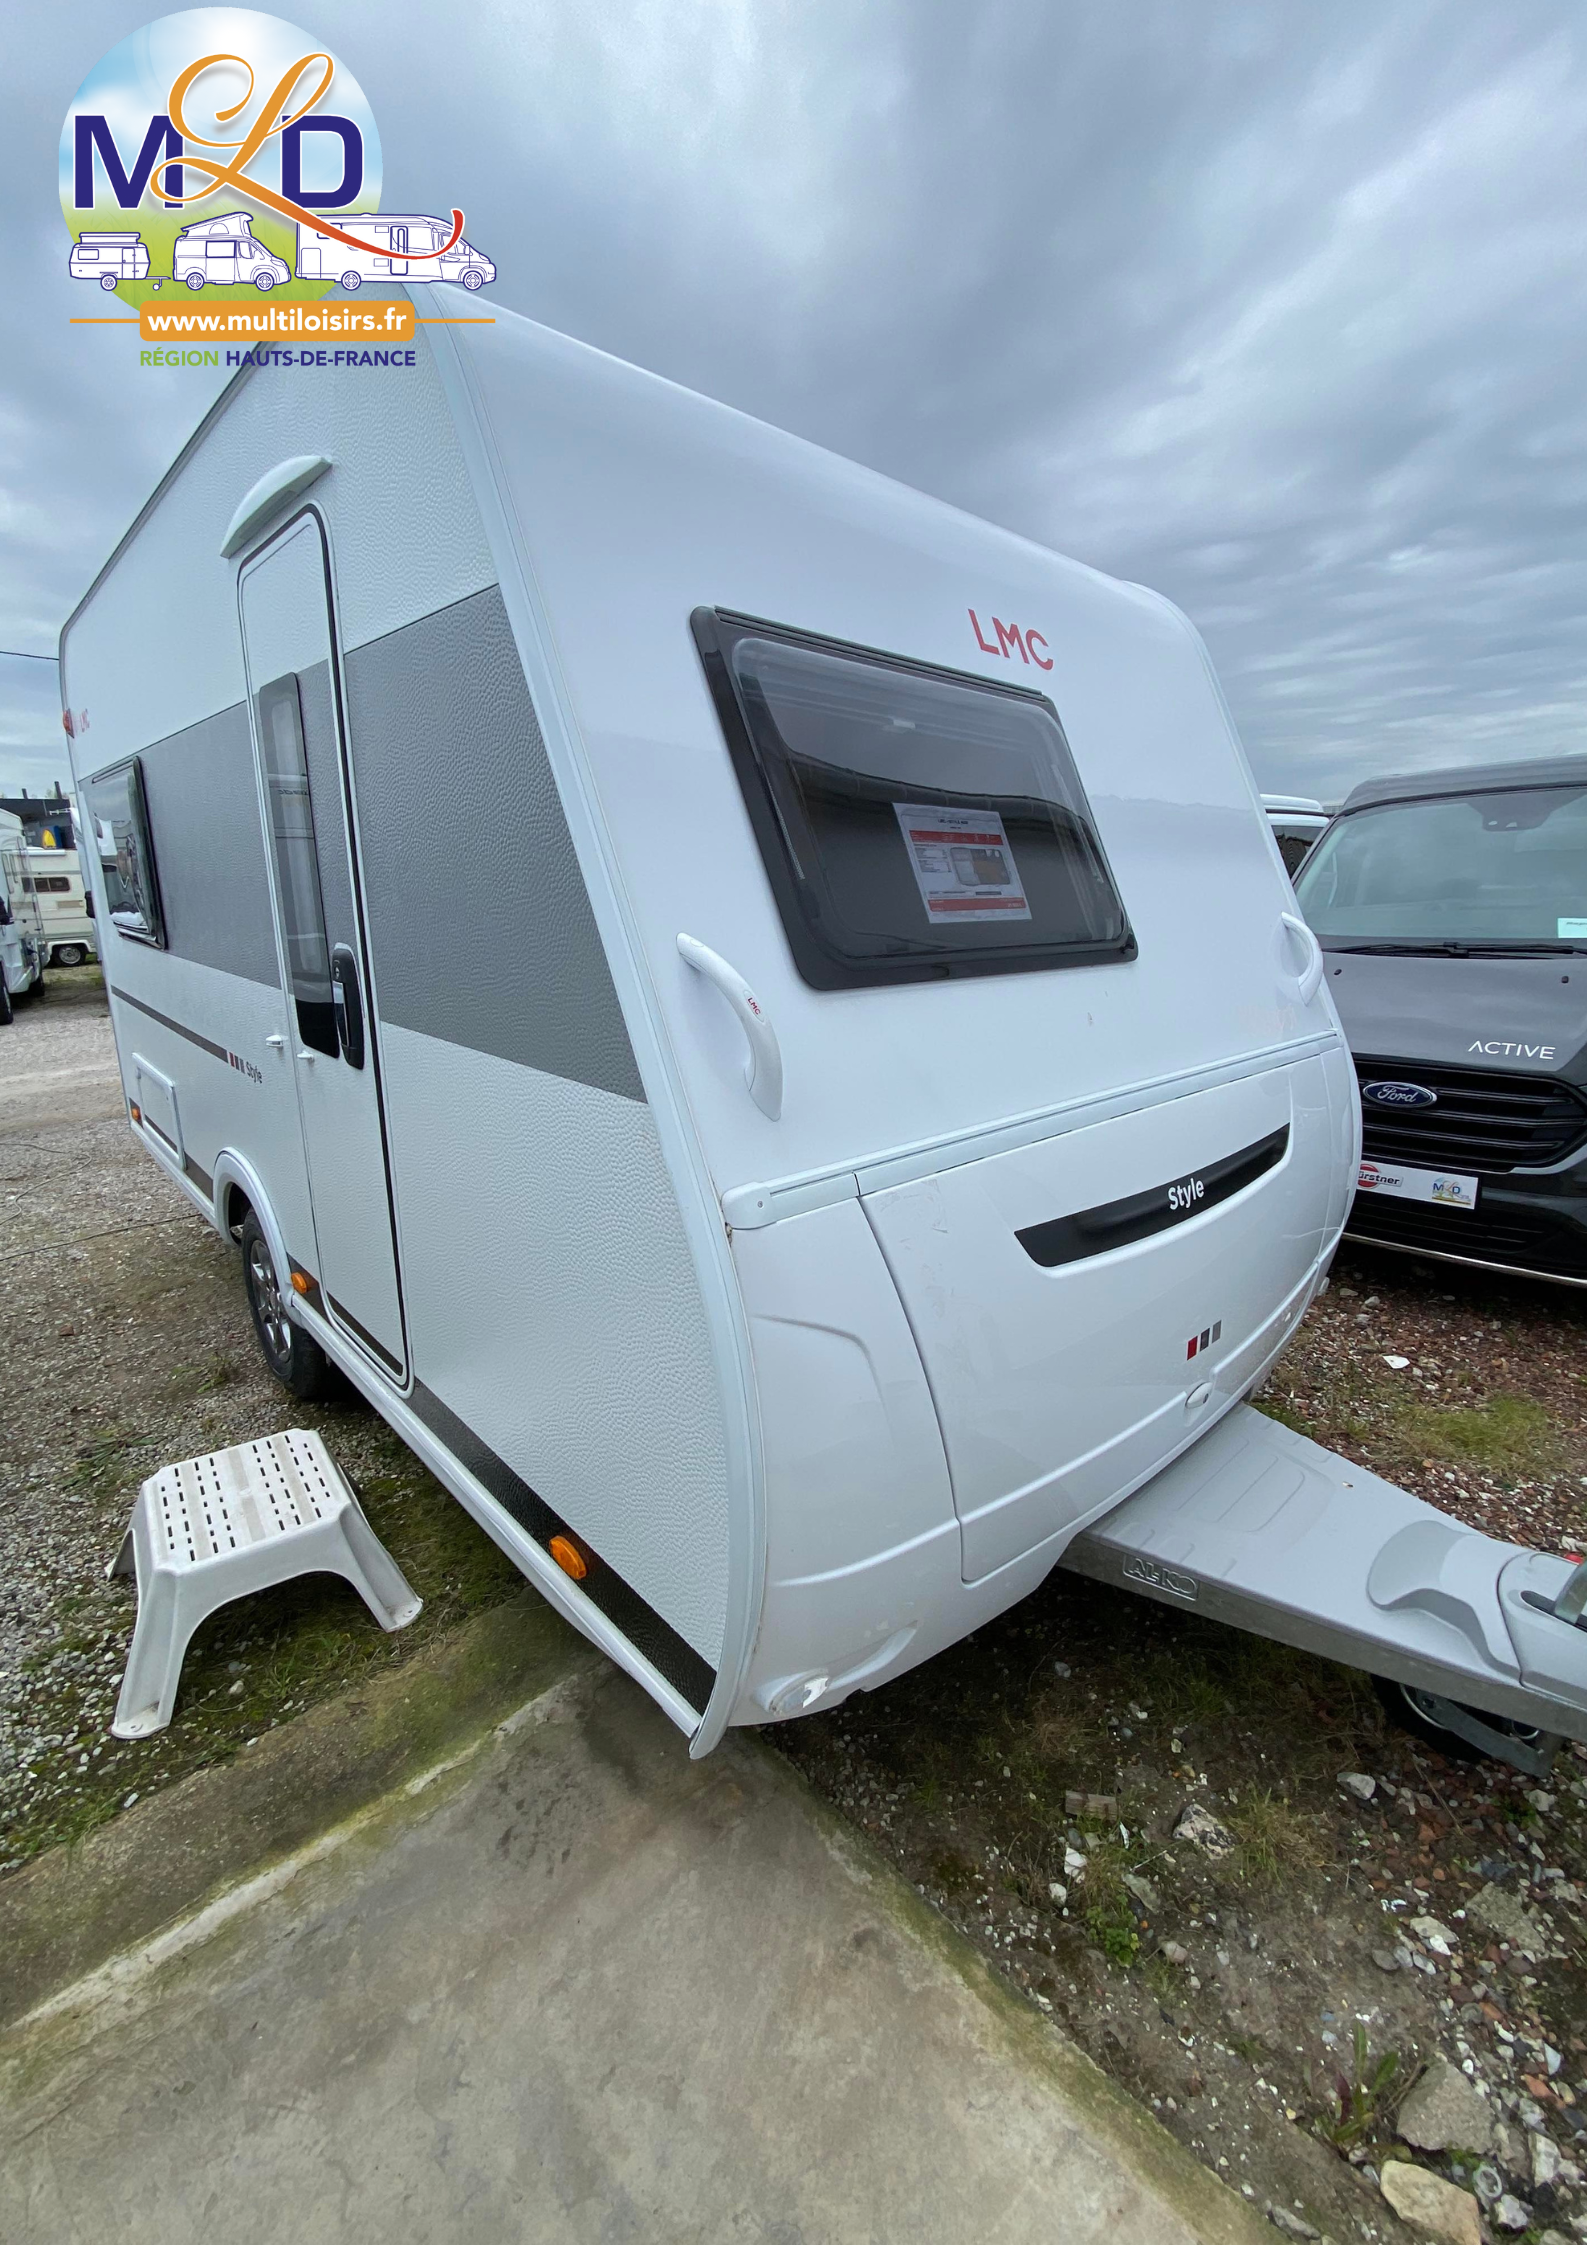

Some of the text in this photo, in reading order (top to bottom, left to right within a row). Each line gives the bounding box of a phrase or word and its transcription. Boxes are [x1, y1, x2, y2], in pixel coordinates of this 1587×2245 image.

[967, 608, 1054, 671] LMC
[747, 997, 761, 1015] LMC
[1468, 1040, 1556, 1060] ACTIVE
[246, 1061, 262, 1084] Style
[1377, 1085, 1419, 1102] Ford
[1358, 1170, 1401, 1185] ürstner
[1168, 1177, 1205, 1210] Style
